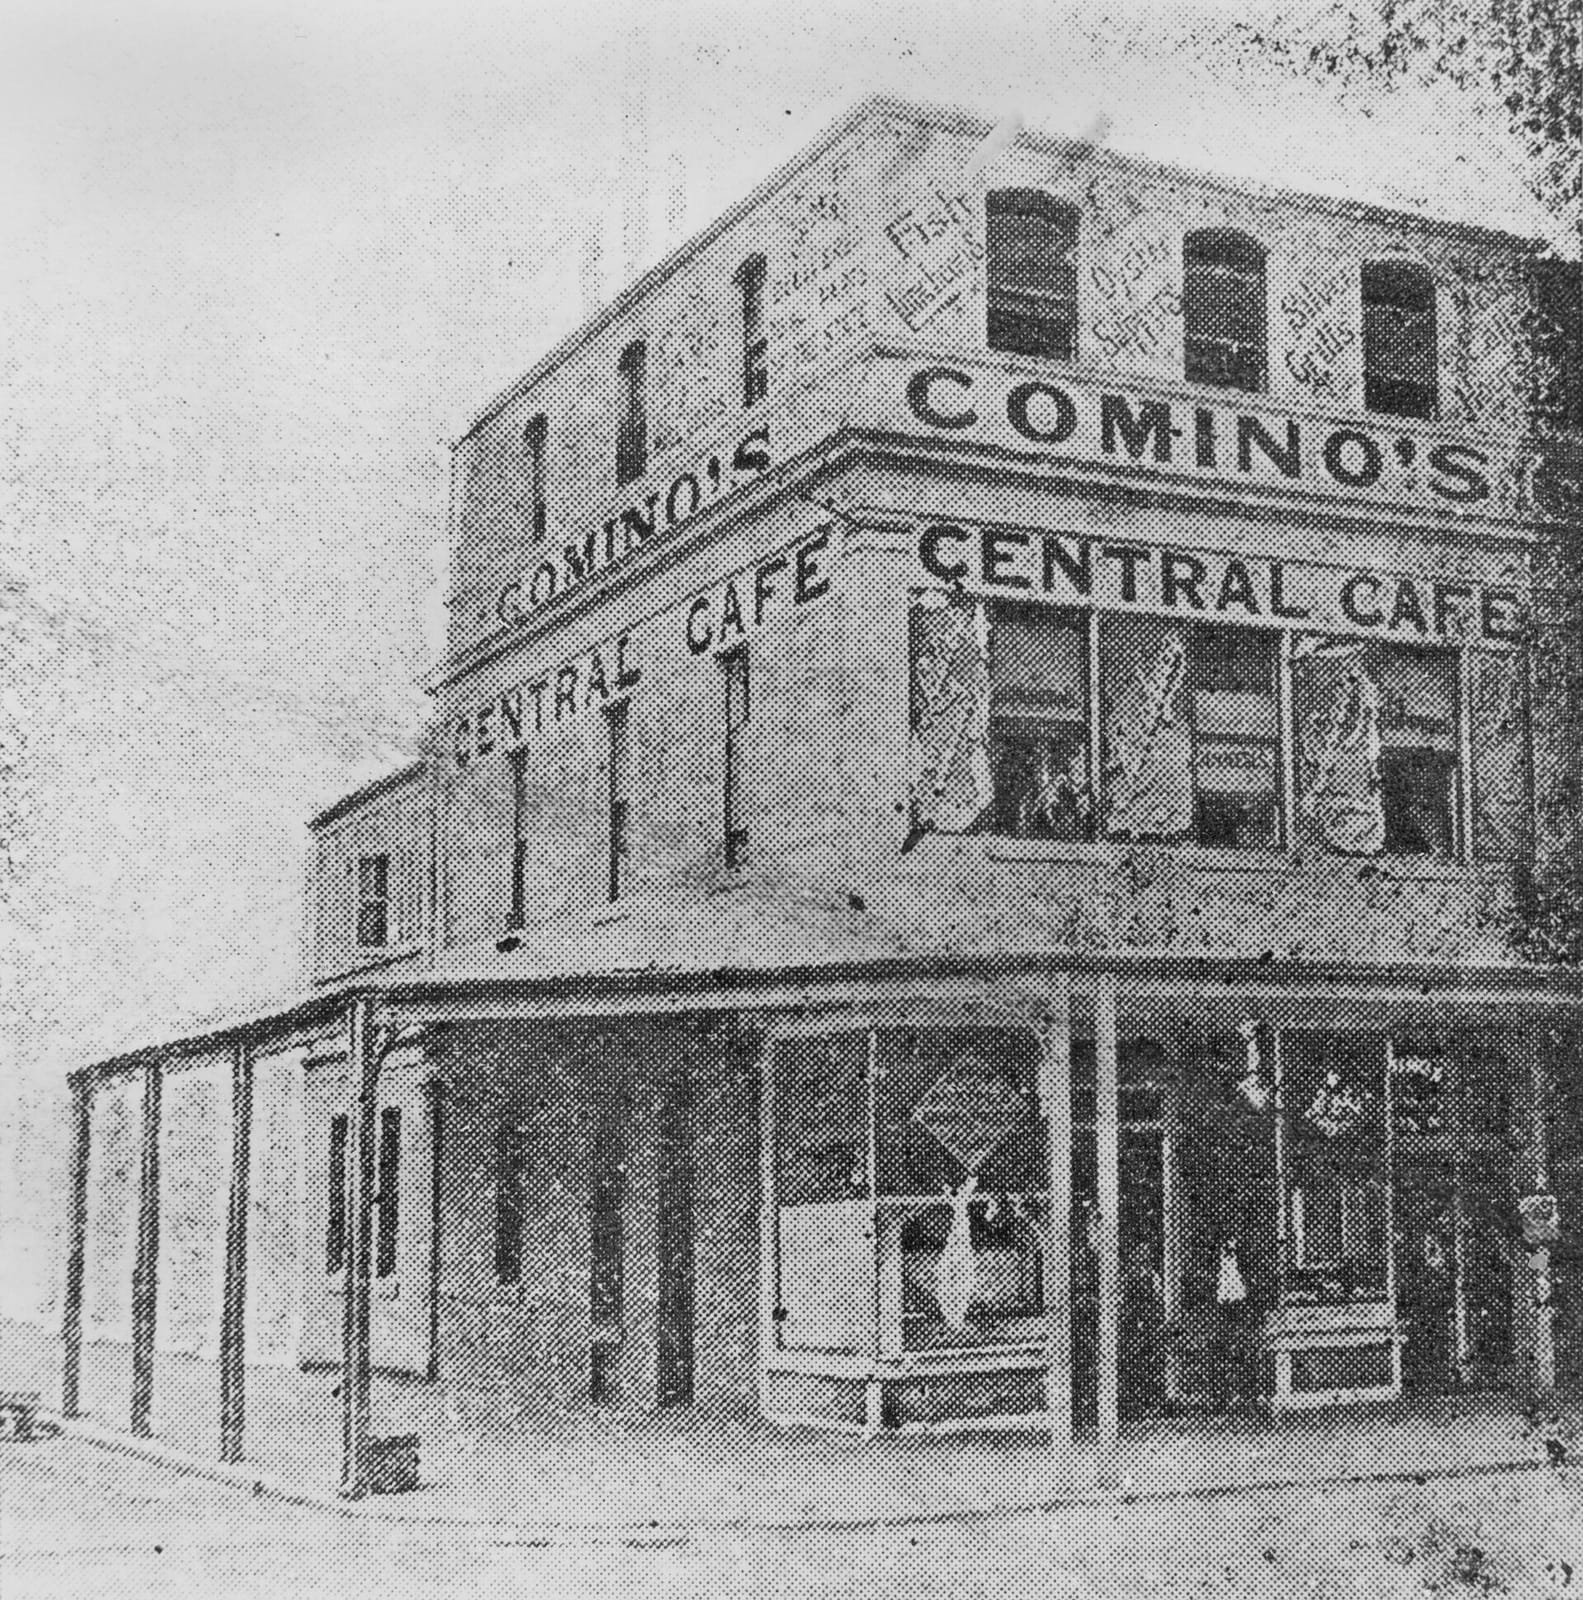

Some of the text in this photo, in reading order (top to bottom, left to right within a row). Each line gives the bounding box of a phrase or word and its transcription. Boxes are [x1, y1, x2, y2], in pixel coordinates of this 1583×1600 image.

[885, 190, 972, 259] Fish
[1281, 268, 1351, 330] Silver
[1285, 320, 1355, 385] Grills
[906, 365, 1490, 500] COMINO'S
[501, 423, 769, 627] COMINO'S
[918, 523, 1517, 639] CENTRAL CAFE
[455, 522, 831, 767] CENTRAL CAFE
